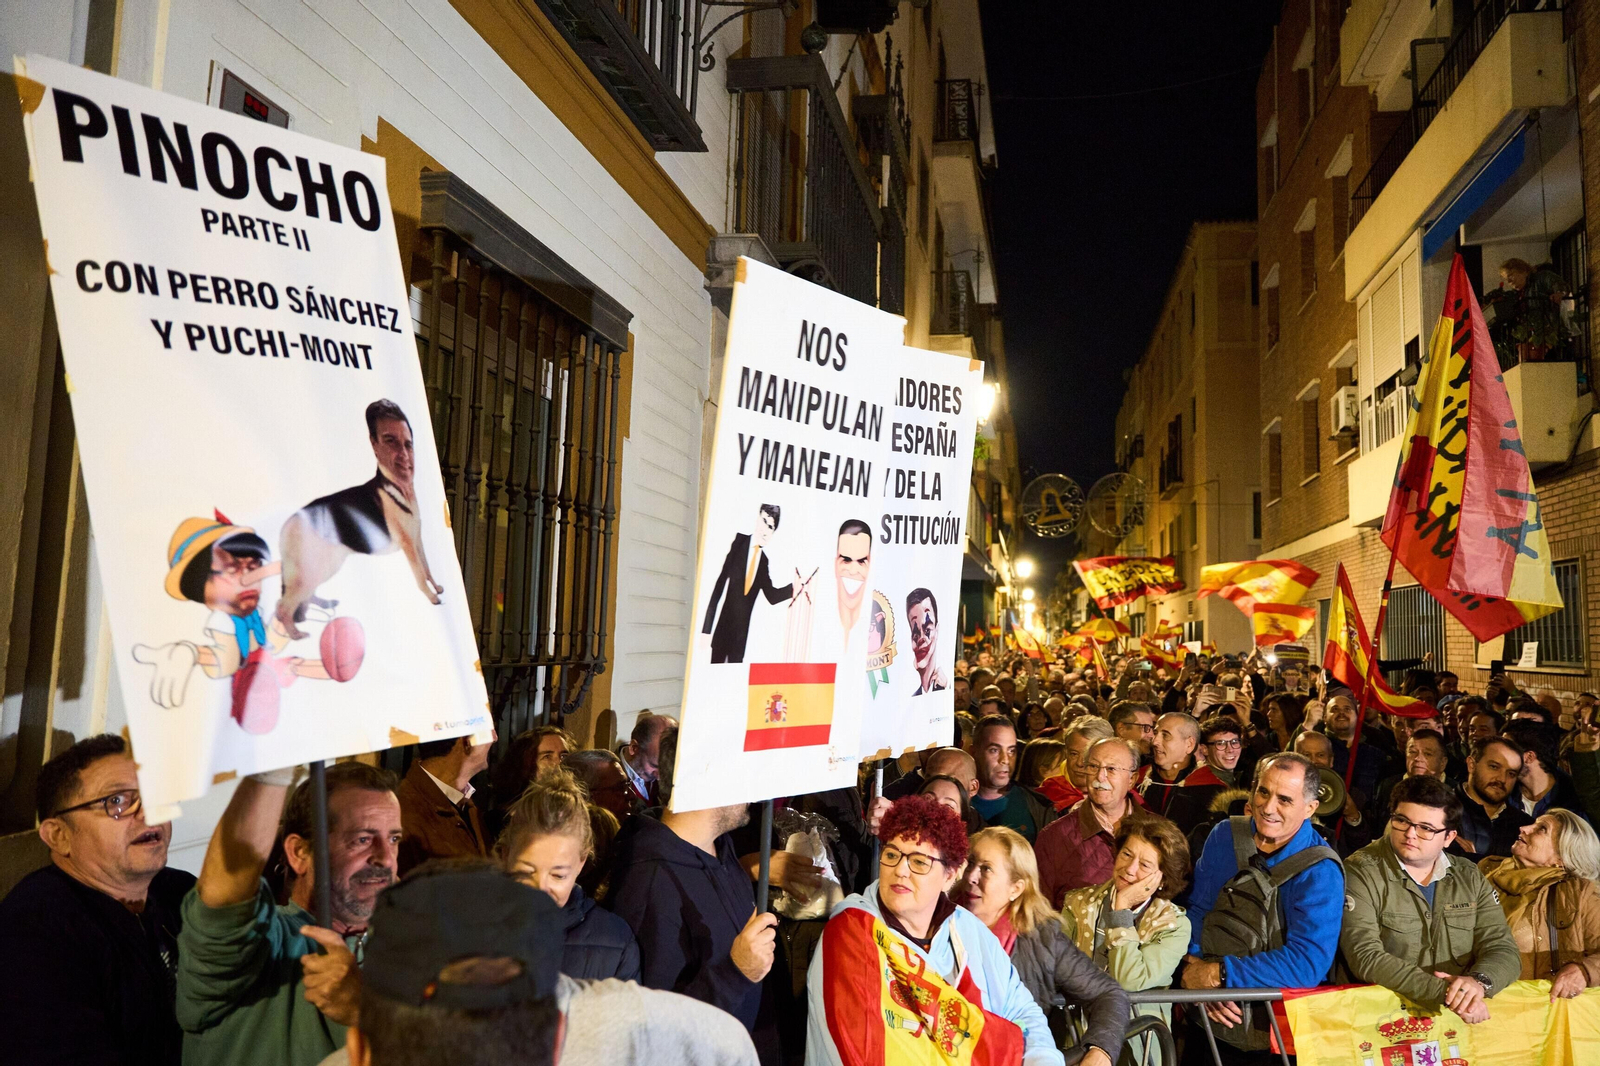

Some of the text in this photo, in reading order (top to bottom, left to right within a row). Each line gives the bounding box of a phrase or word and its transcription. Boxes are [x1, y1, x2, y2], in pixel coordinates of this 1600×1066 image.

[51, 87, 381, 232] PINOCHO
[200, 208, 311, 252] PARTE II
[75, 259, 402, 334] CON PERRO SÁNCHEZ
[150, 318, 373, 370] Y PUCHI-MONT
[797, 319, 848, 372] NOS
[737, 366, 883, 442] MANIPULAN
[895, 377, 963, 415] IDORES
[738, 432, 755, 476] Y
[757, 438, 872, 498] MANEJAN
[891, 421, 957, 459] ESPAÑA
[894, 468, 917, 500] DE
[920, 471, 943, 502] LA
[880, 510, 961, 545] STITUCIÓN
